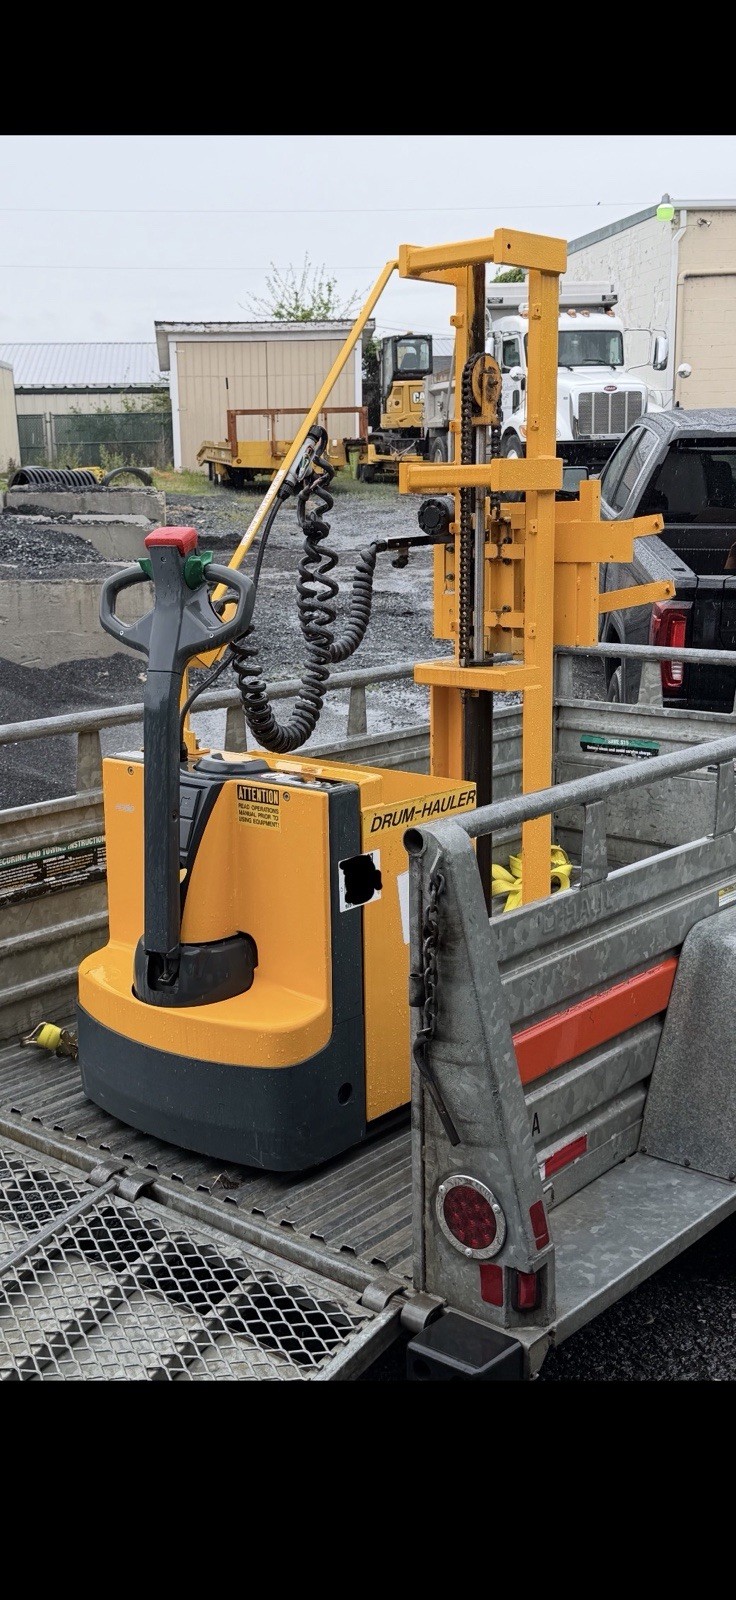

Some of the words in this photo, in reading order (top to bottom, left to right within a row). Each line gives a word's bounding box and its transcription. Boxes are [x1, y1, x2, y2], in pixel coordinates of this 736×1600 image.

[413, 392, 425, 403] CA
[238, 786, 279, 805] ATTENTION
[239, 810, 257, 818] MANUAL
[251, 805, 279, 814] OPERATIONS
[370, 790, 477, 832] DRUM-HAULER
[0, 854, 27, 866] ECURING
[27, 850, 42, 859] AND
[532, 1112, 541, 1137] A
